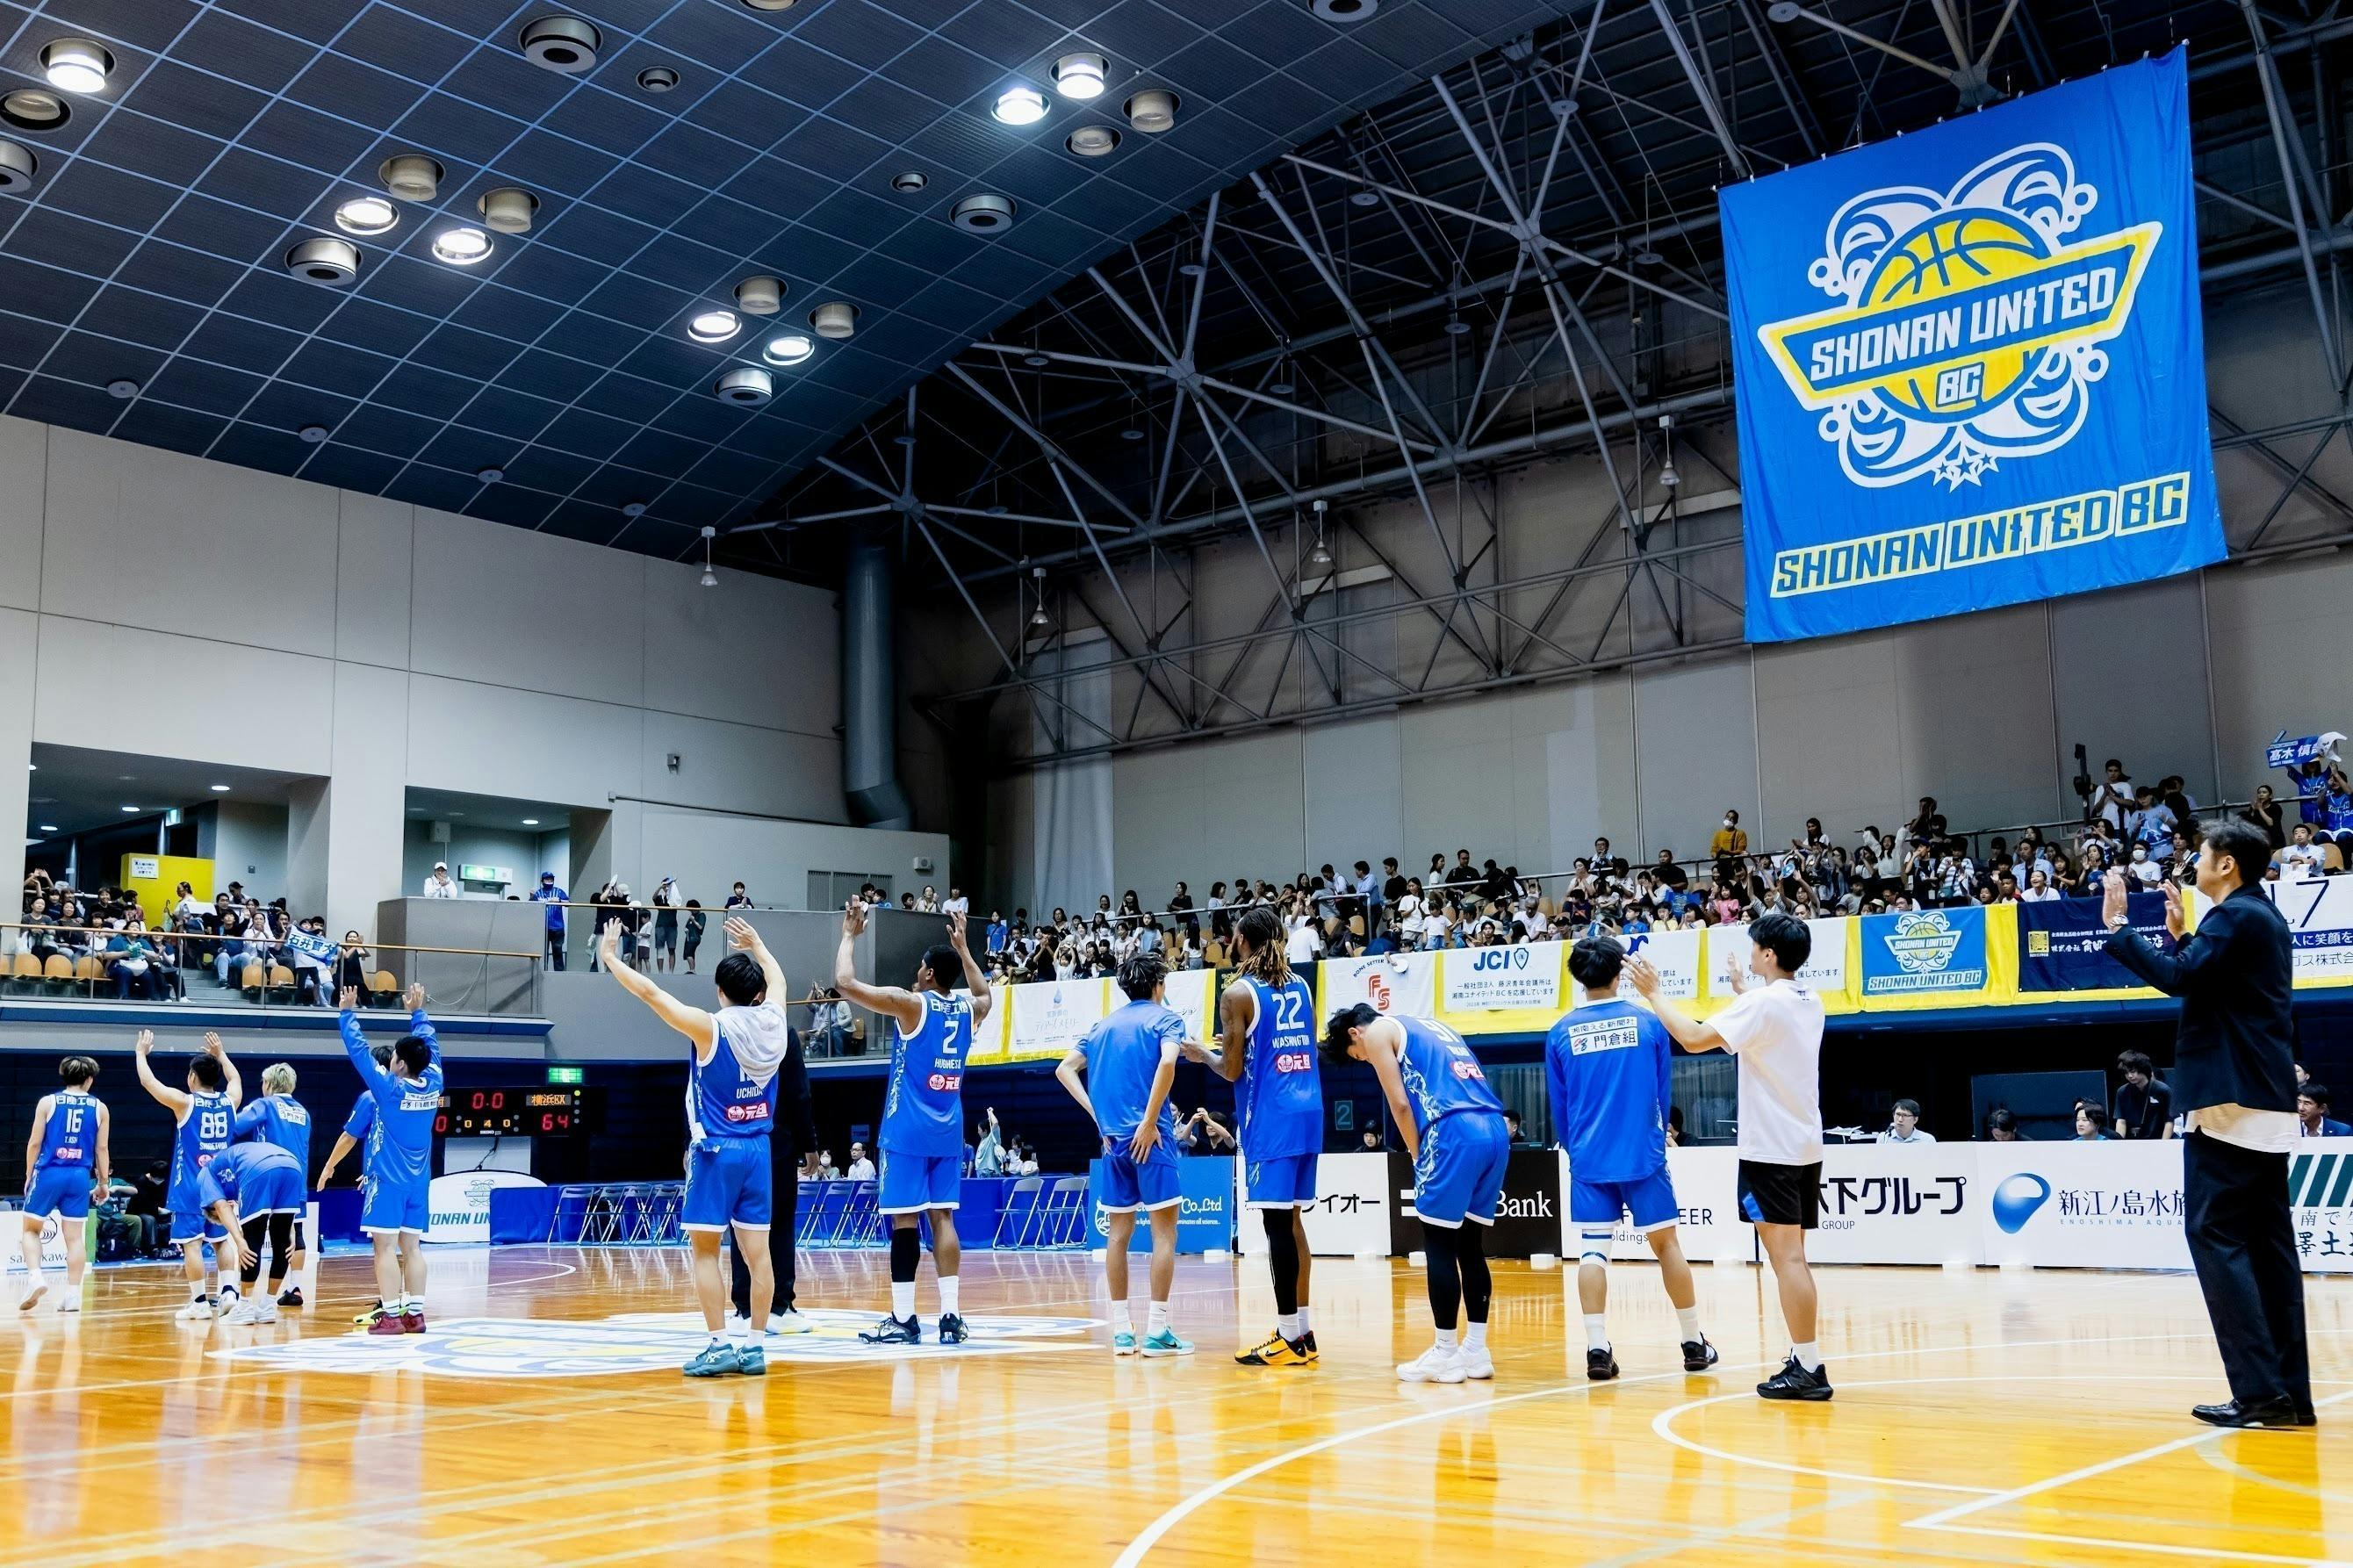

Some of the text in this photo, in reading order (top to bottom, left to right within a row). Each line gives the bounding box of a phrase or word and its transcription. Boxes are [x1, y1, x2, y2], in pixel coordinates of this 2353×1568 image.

[1810, 266, 2117, 381] SHONAN UNITED
[1937, 365, 1982, 405] BC
[1774, 475, 2187, 593] SHONAN UNITED BC
[1895, 937, 1954, 949] SHONAN UNITED
[1473, 950, 1510, 971] JCI
[1869, 971, 1981, 989] SHONAN UNITED BC
[1270, 990, 1306, 1031] 22
[942, 1020, 960, 1054] 2
[1594, 1030, 1637, 1048] 門倉組
[472, 1092, 504, 1110] 0.0
[531, 1093, 566, 1106] 横浜EX
[736, 1086, 763, 1099] UCHIDA
[66, 1108, 84, 1133] 16
[199, 1111, 228, 1139] 88
[542, 1113, 569, 1131] 64
[1336, 1104, 1351, 1126] 2
[1181, 1195, 1223, 1214] Co.,Ltd
[1493, 1190, 1554, 1218] Bank
[429, 1212, 471, 1226] ONAN
[1821, 1220, 1855, 1230] GROUP
